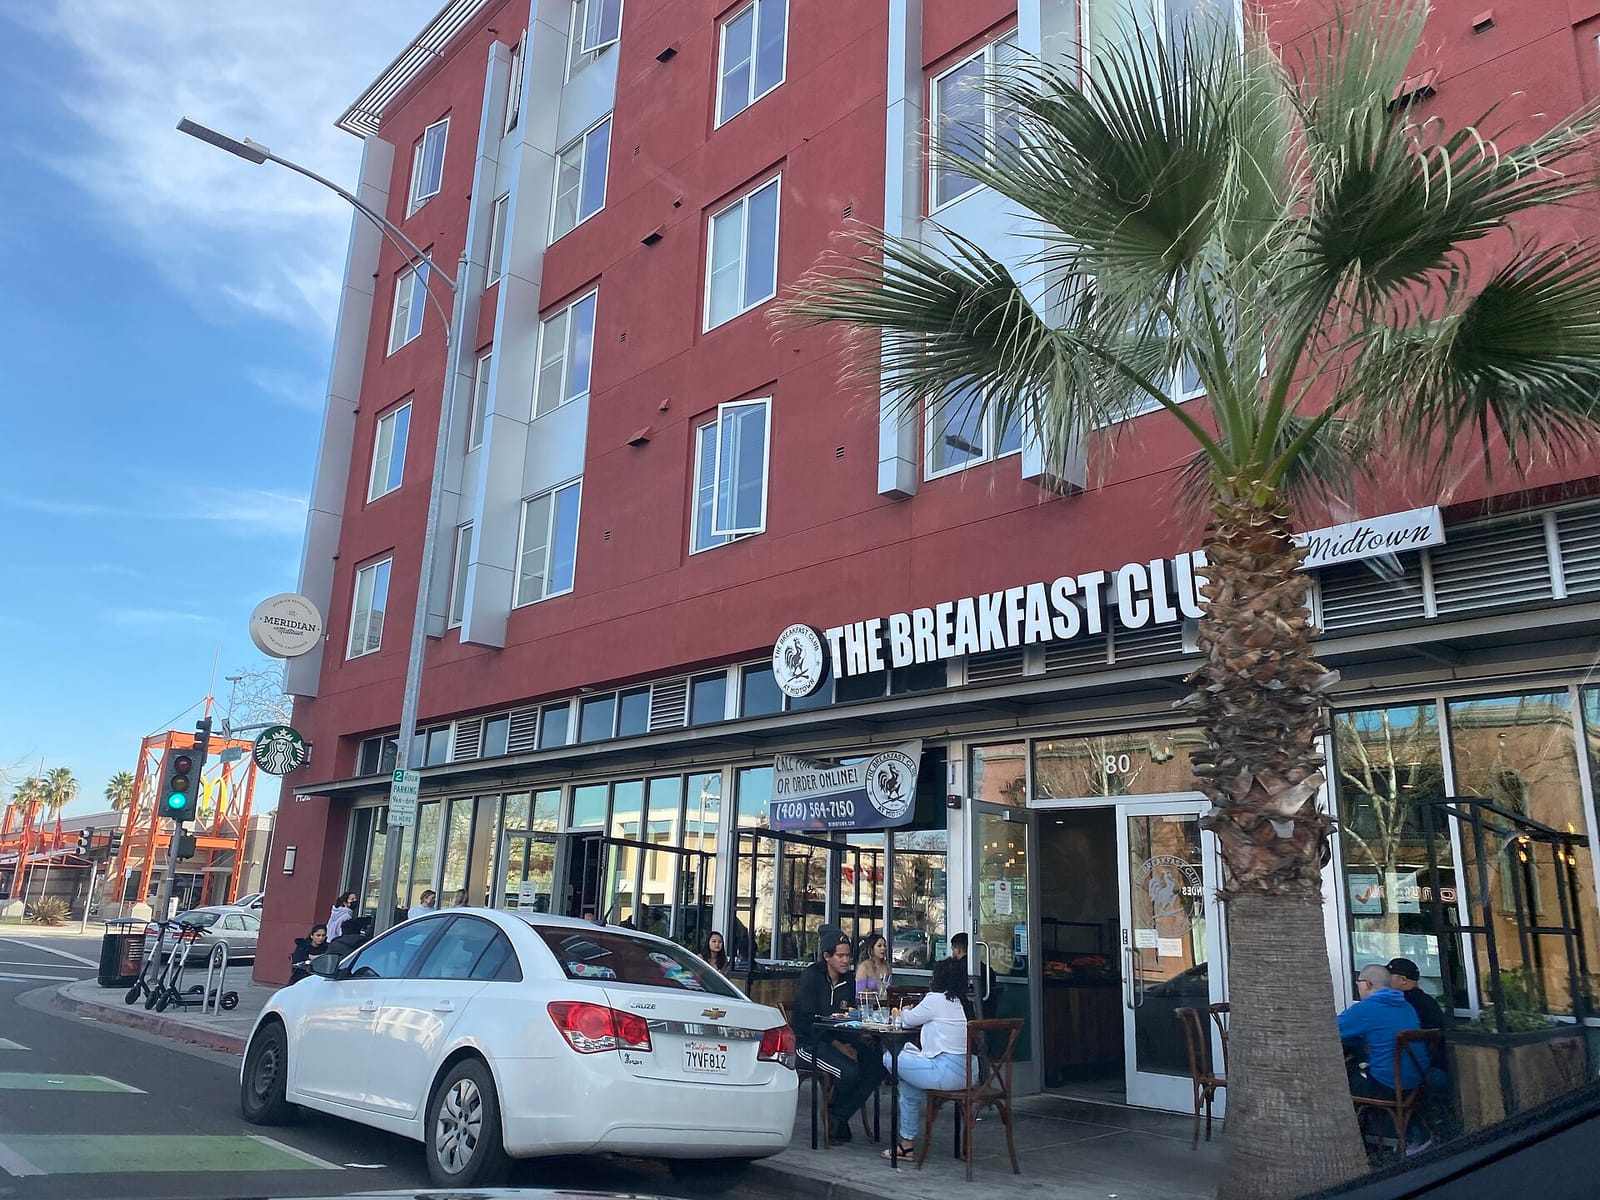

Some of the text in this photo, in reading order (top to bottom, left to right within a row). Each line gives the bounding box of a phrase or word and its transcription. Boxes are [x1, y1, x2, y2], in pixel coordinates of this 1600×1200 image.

[1308, 525, 1432, 561] Midtown
[264, 615, 317, 632] MERIDIAN
[826, 550, 1212, 680] THE BREAKFAST CLU
[779, 626, 809, 646] BREAKFAST
[808, 633, 820, 651] CLUB
[790, 677, 815, 694] MIDTOWN
[775, 756, 794, 773] CALL
[1105, 754, 1130, 774] 80
[395, 771, 403, 781] 2
[777, 769, 858, 794] OR ORDER ONLINE!
[393, 784, 417, 795] PARKING
[776, 800, 855, 821] (408) 564-7150
[990, 946, 1012, 961] OPE
[685, 1051, 727, 1069] 7YVF812
